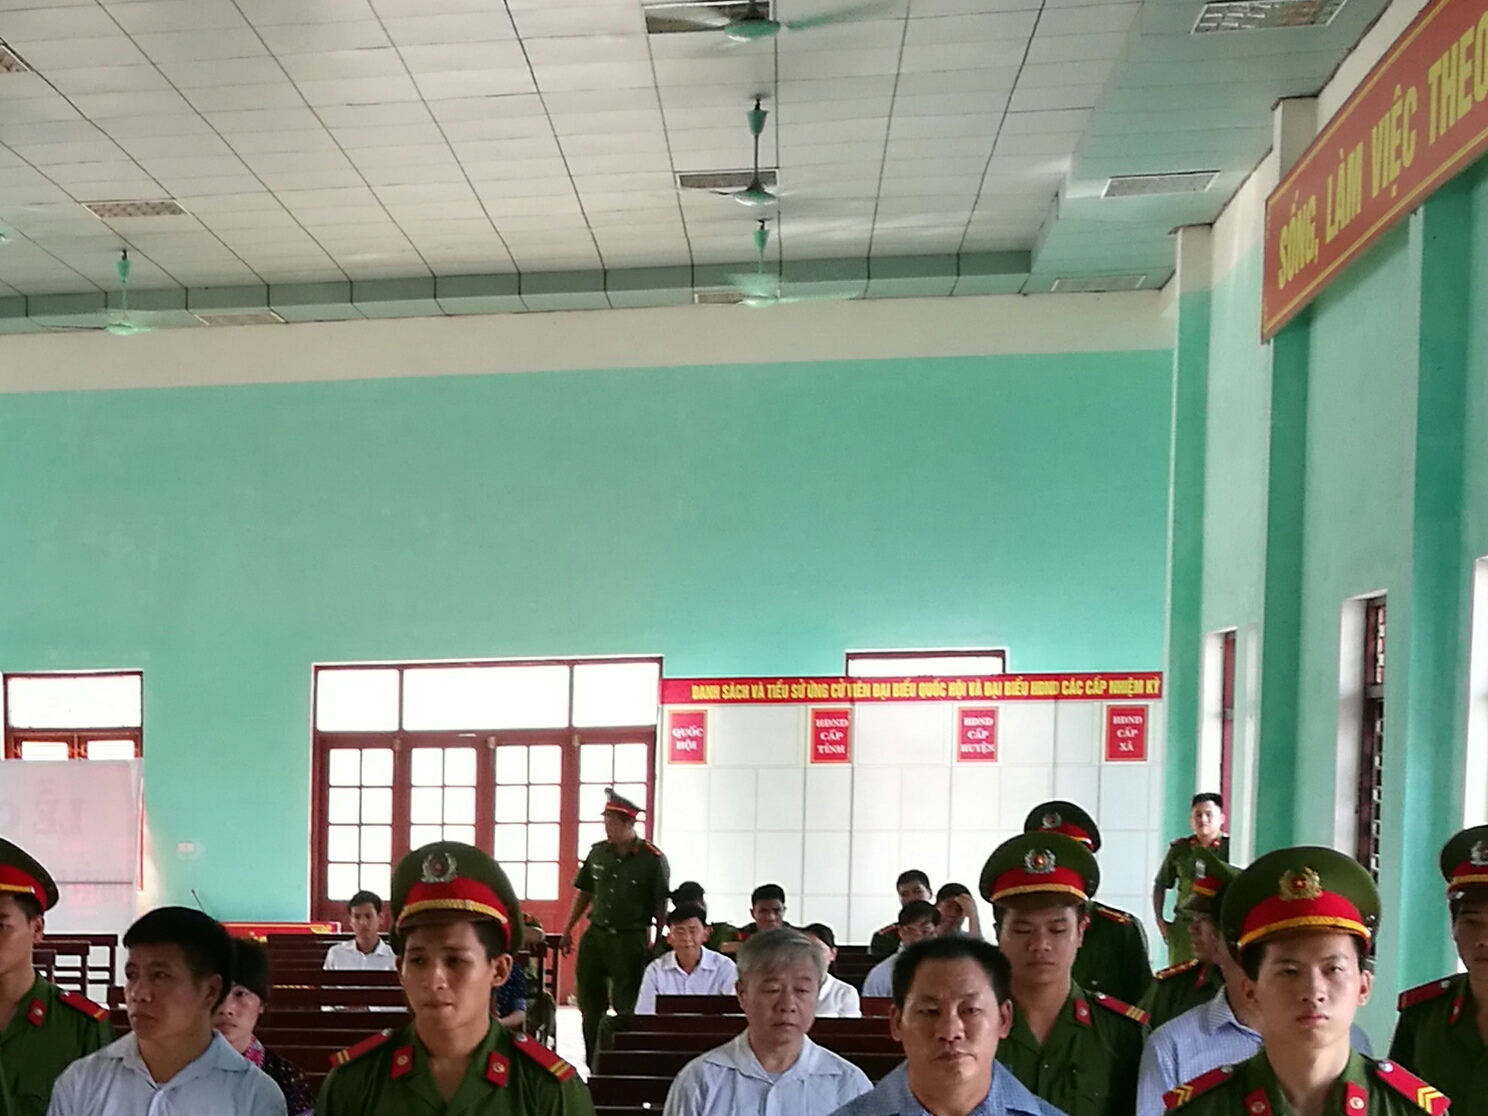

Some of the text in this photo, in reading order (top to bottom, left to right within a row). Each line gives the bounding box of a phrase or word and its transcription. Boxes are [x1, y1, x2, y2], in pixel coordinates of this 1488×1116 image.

[1325, 141, 1363, 244] LÀM
[1371, 84, 1418, 198] VIỆC
[1428, 10, 1488, 145] THEO
